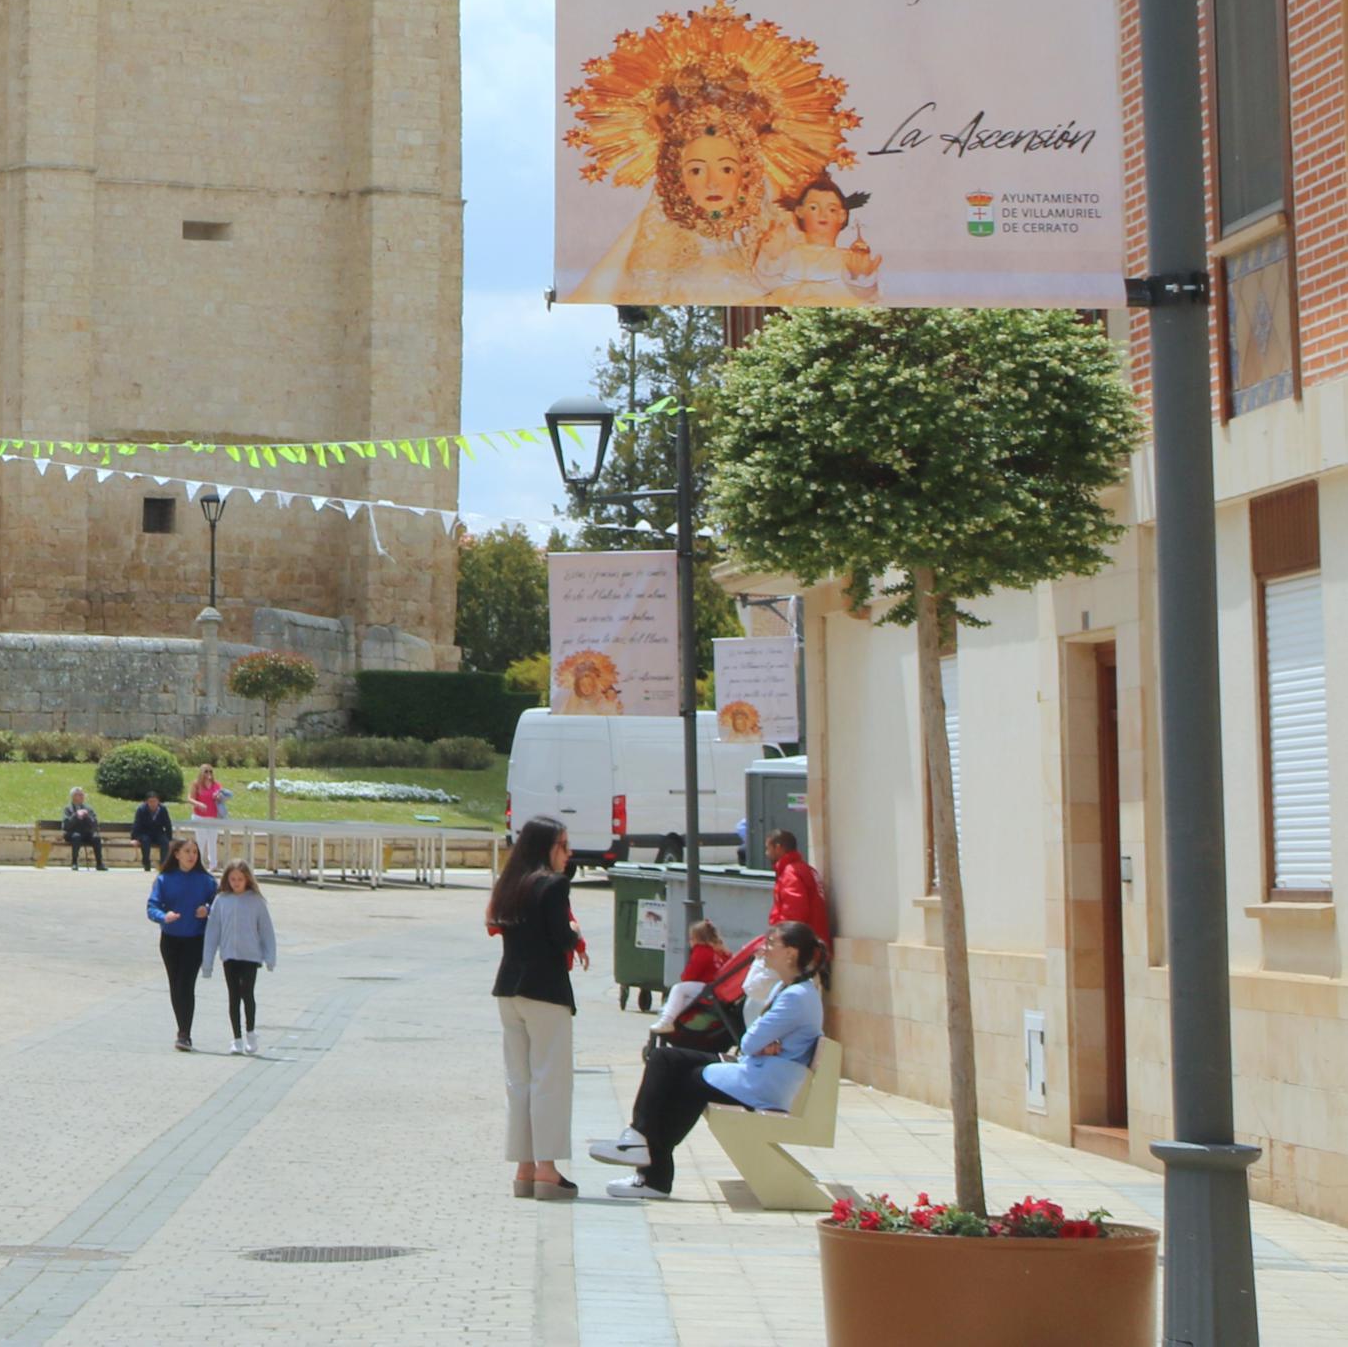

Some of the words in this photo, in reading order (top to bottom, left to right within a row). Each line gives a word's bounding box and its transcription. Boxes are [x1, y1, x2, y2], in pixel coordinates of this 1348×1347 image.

[867, 102, 937, 156] La
[939, 110, 1097, 159] Ascensión
[1000, 193, 1100, 204] AYUNTAMIENTO
[1001, 208, 1018, 218] DE
[1021, 208, 1102, 219] VILLAMURIEL
[1002, 223, 1019, 233] DE
[1021, 223, 1080, 234] CERRATO
